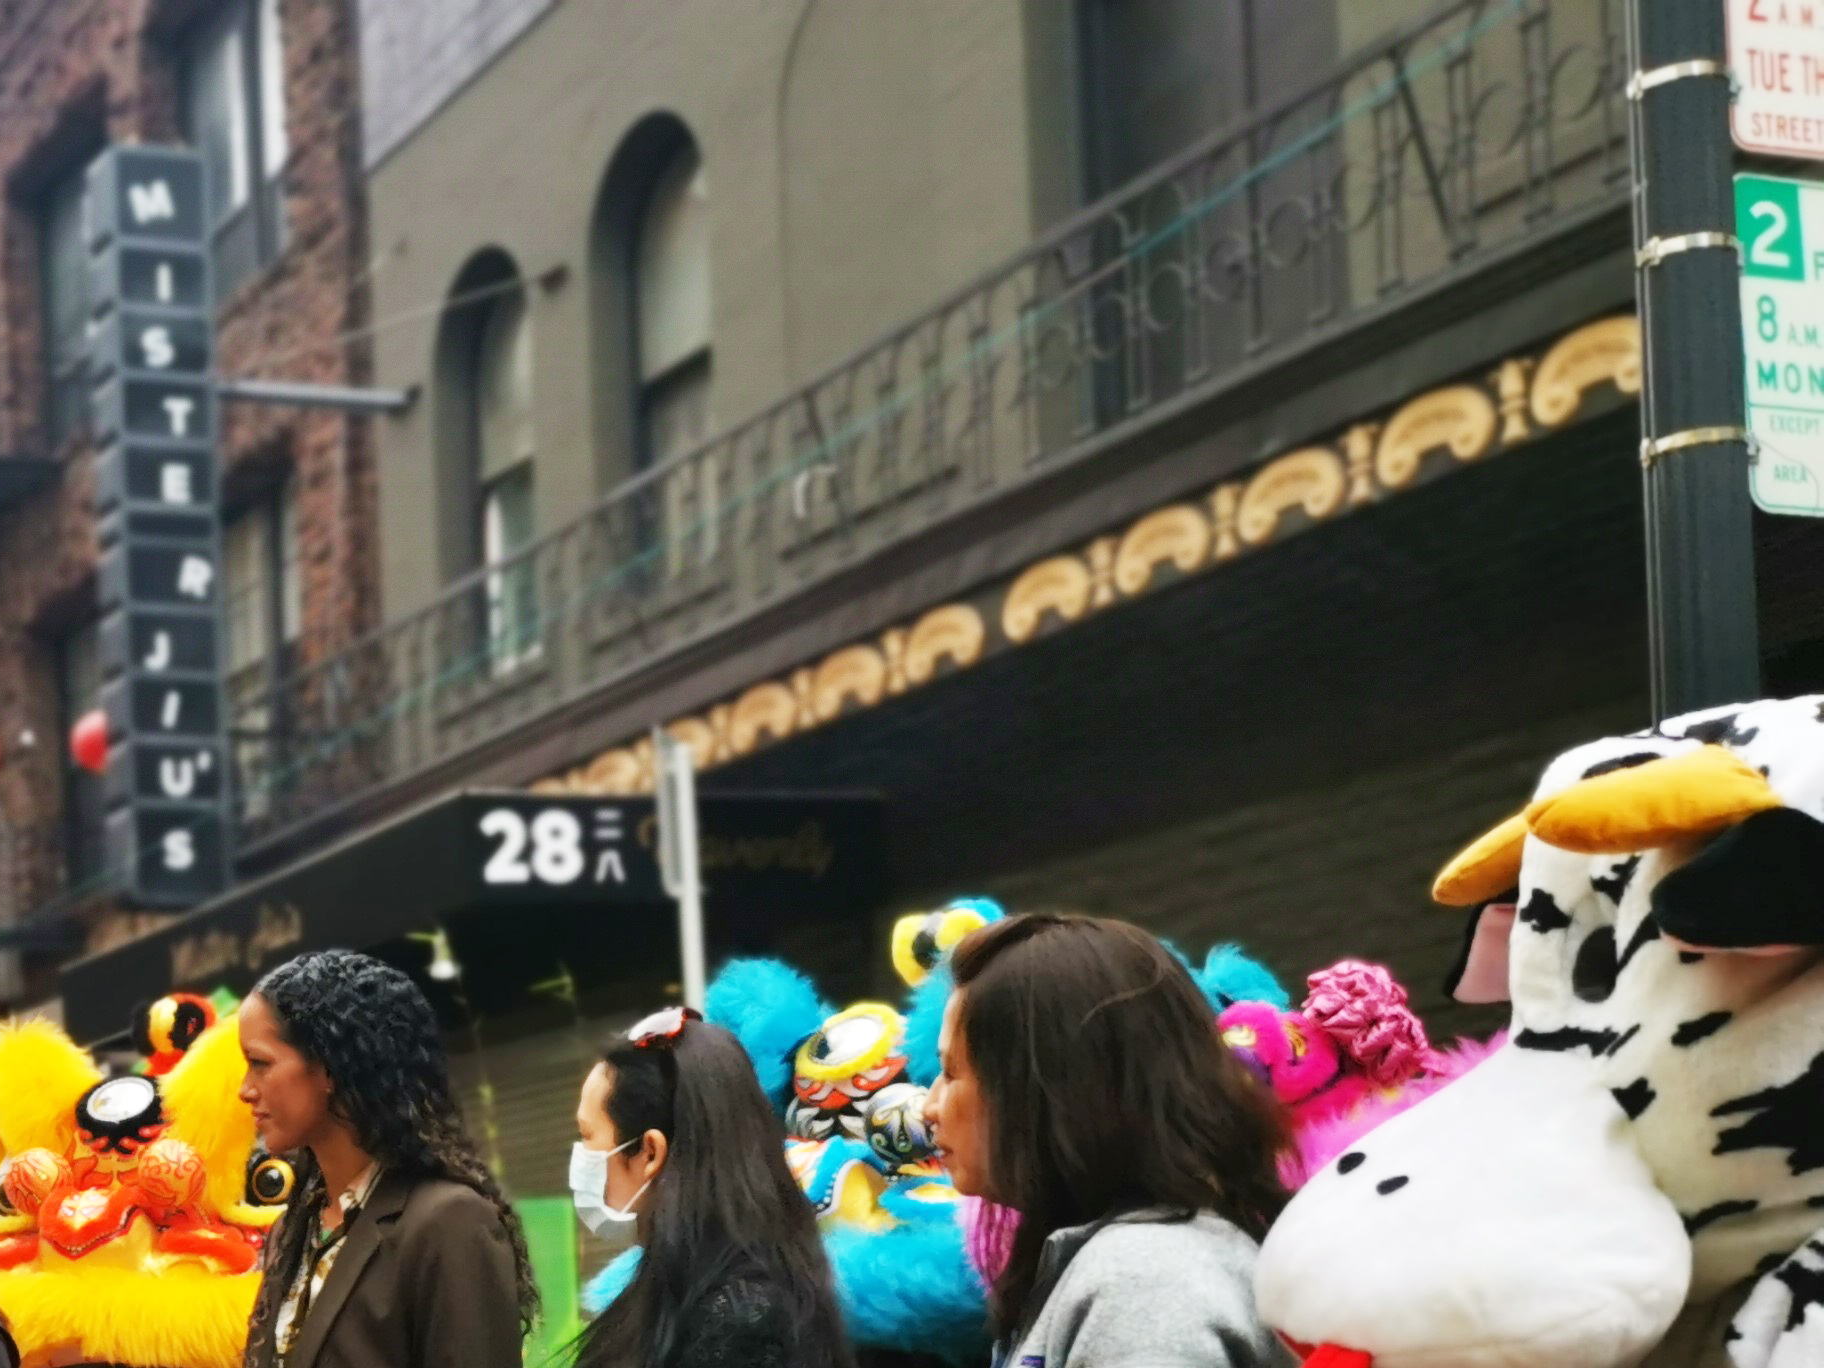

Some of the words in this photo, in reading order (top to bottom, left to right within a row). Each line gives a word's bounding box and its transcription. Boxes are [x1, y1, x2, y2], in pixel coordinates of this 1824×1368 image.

[1746, 48, 1792, 93] TUE
[1751, 111, 1824, 144] STREET
[1748, 200, 1791, 268] 2
[1758, 293, 1777, 342] 8
[128, 178, 214, 598] MISTER
[1756, 359, 1824, 395] MON
[1769, 414, 1820, 436] EXCEPT
[1773, 465, 1808, 483] AREA
[479, 808, 585, 884] 28
